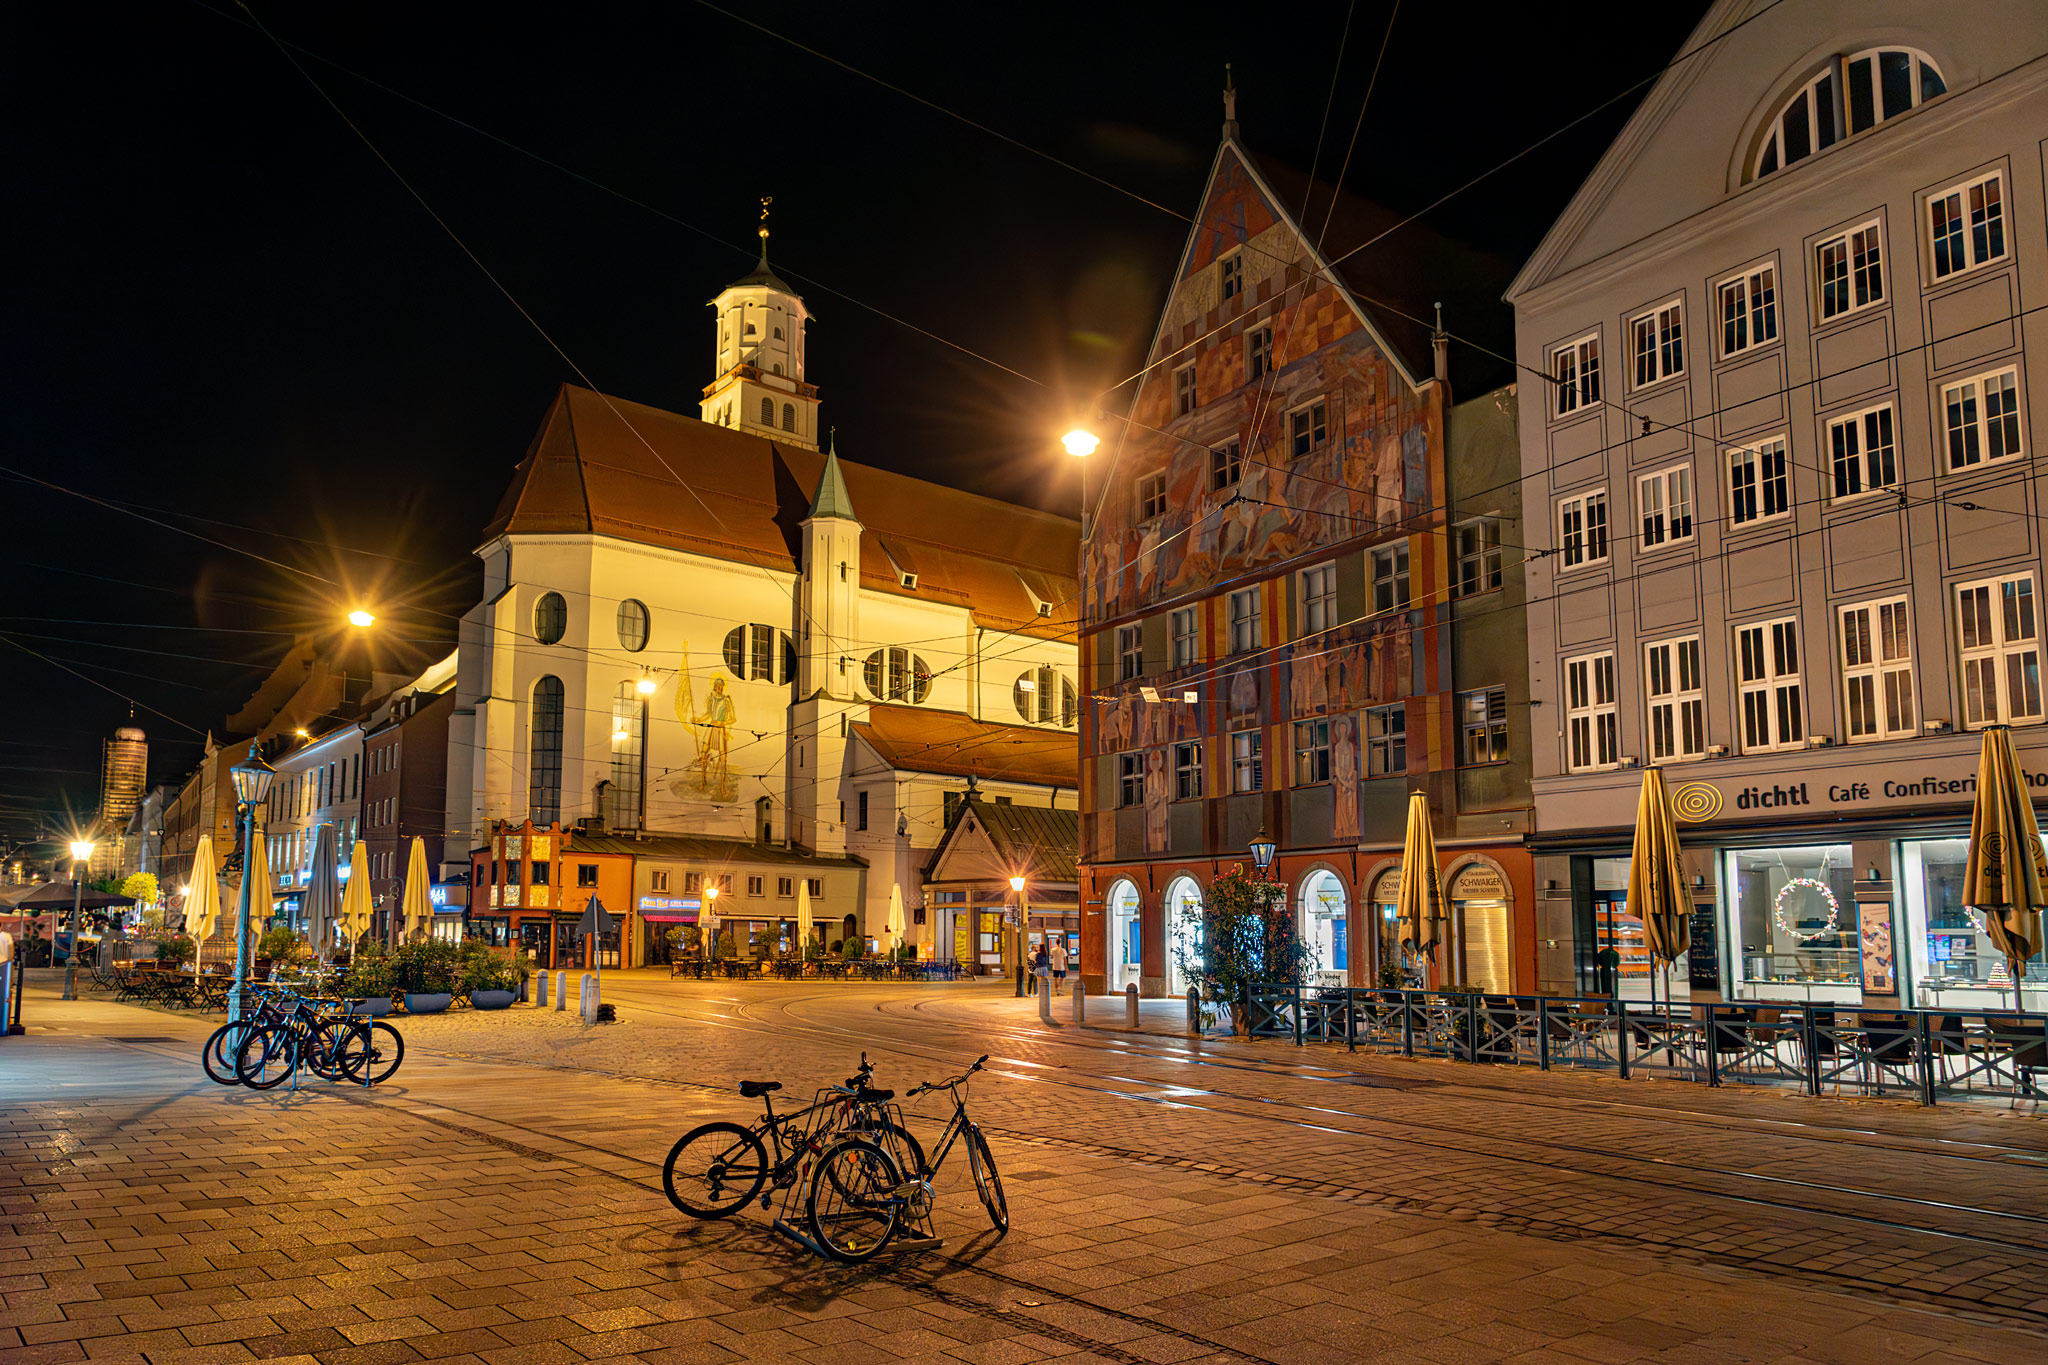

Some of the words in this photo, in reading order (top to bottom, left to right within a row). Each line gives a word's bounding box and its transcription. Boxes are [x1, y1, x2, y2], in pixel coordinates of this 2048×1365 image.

[1737, 783, 1810, 809] dichtl
[1829, 783, 1870, 802] Café
[1884, 774, 1977, 798] Confiseri
[1460, 878, 1502, 887] SCHWAIGER
